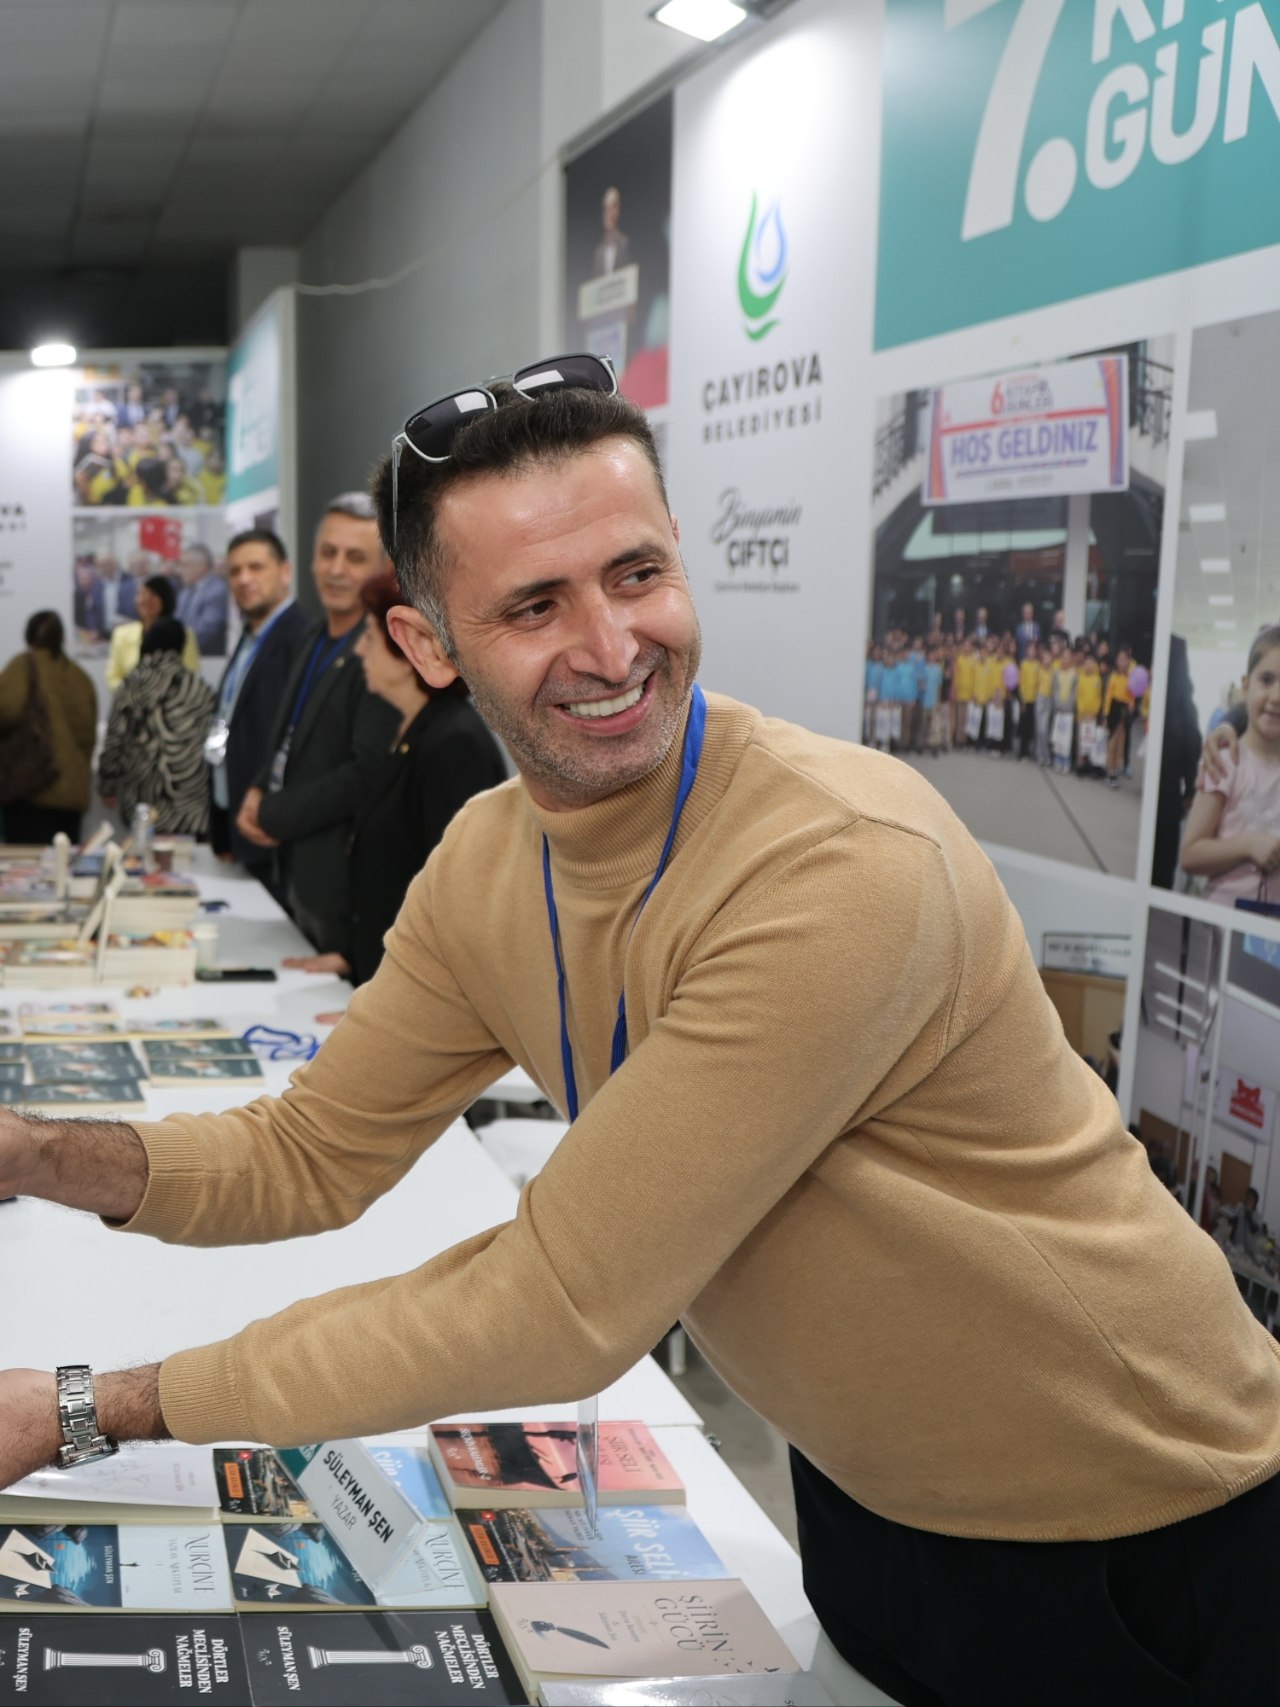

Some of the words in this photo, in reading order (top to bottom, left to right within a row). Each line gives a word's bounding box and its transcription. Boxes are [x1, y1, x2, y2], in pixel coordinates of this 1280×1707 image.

[702, 352, 822, 414] ÇAYIROVA
[952, 431, 992, 466] HOŞ
[998, 420, 1099, 460] GELDİNİZ
[323, 1450, 375, 1518] SÜLEYMAN
[368, 1512, 394, 1543] ŞEN
[331, 1494, 357, 1531] YAZAR
[103, 1545, 113, 1572] SÜLEYMAN
[105, 1573, 114, 1584] ŞEN
[655, 1598, 704, 1651] GÜCÜ
[679, 1594, 734, 1652] ŞİİRİN
[17, 1627, 33, 1675] SÜLEYMAN
[176, 1635, 193, 1688] NAĞMELER
[193, 1629, 212, 1693] MECLİSİNDEN
[211, 1639, 229, 1683] DÖRTLER
[277, 1626, 296, 1673] SÜLEYMAN
[435, 1630, 464, 1684] NAĞMELER
[451, 1624, 485, 1689] MECLİSİNDEN
[471, 1634, 499, 1679] DÖRTLER
[13, 1674, 27, 1692] ŞEN
[283, 1672, 301, 1691] ŞEN
